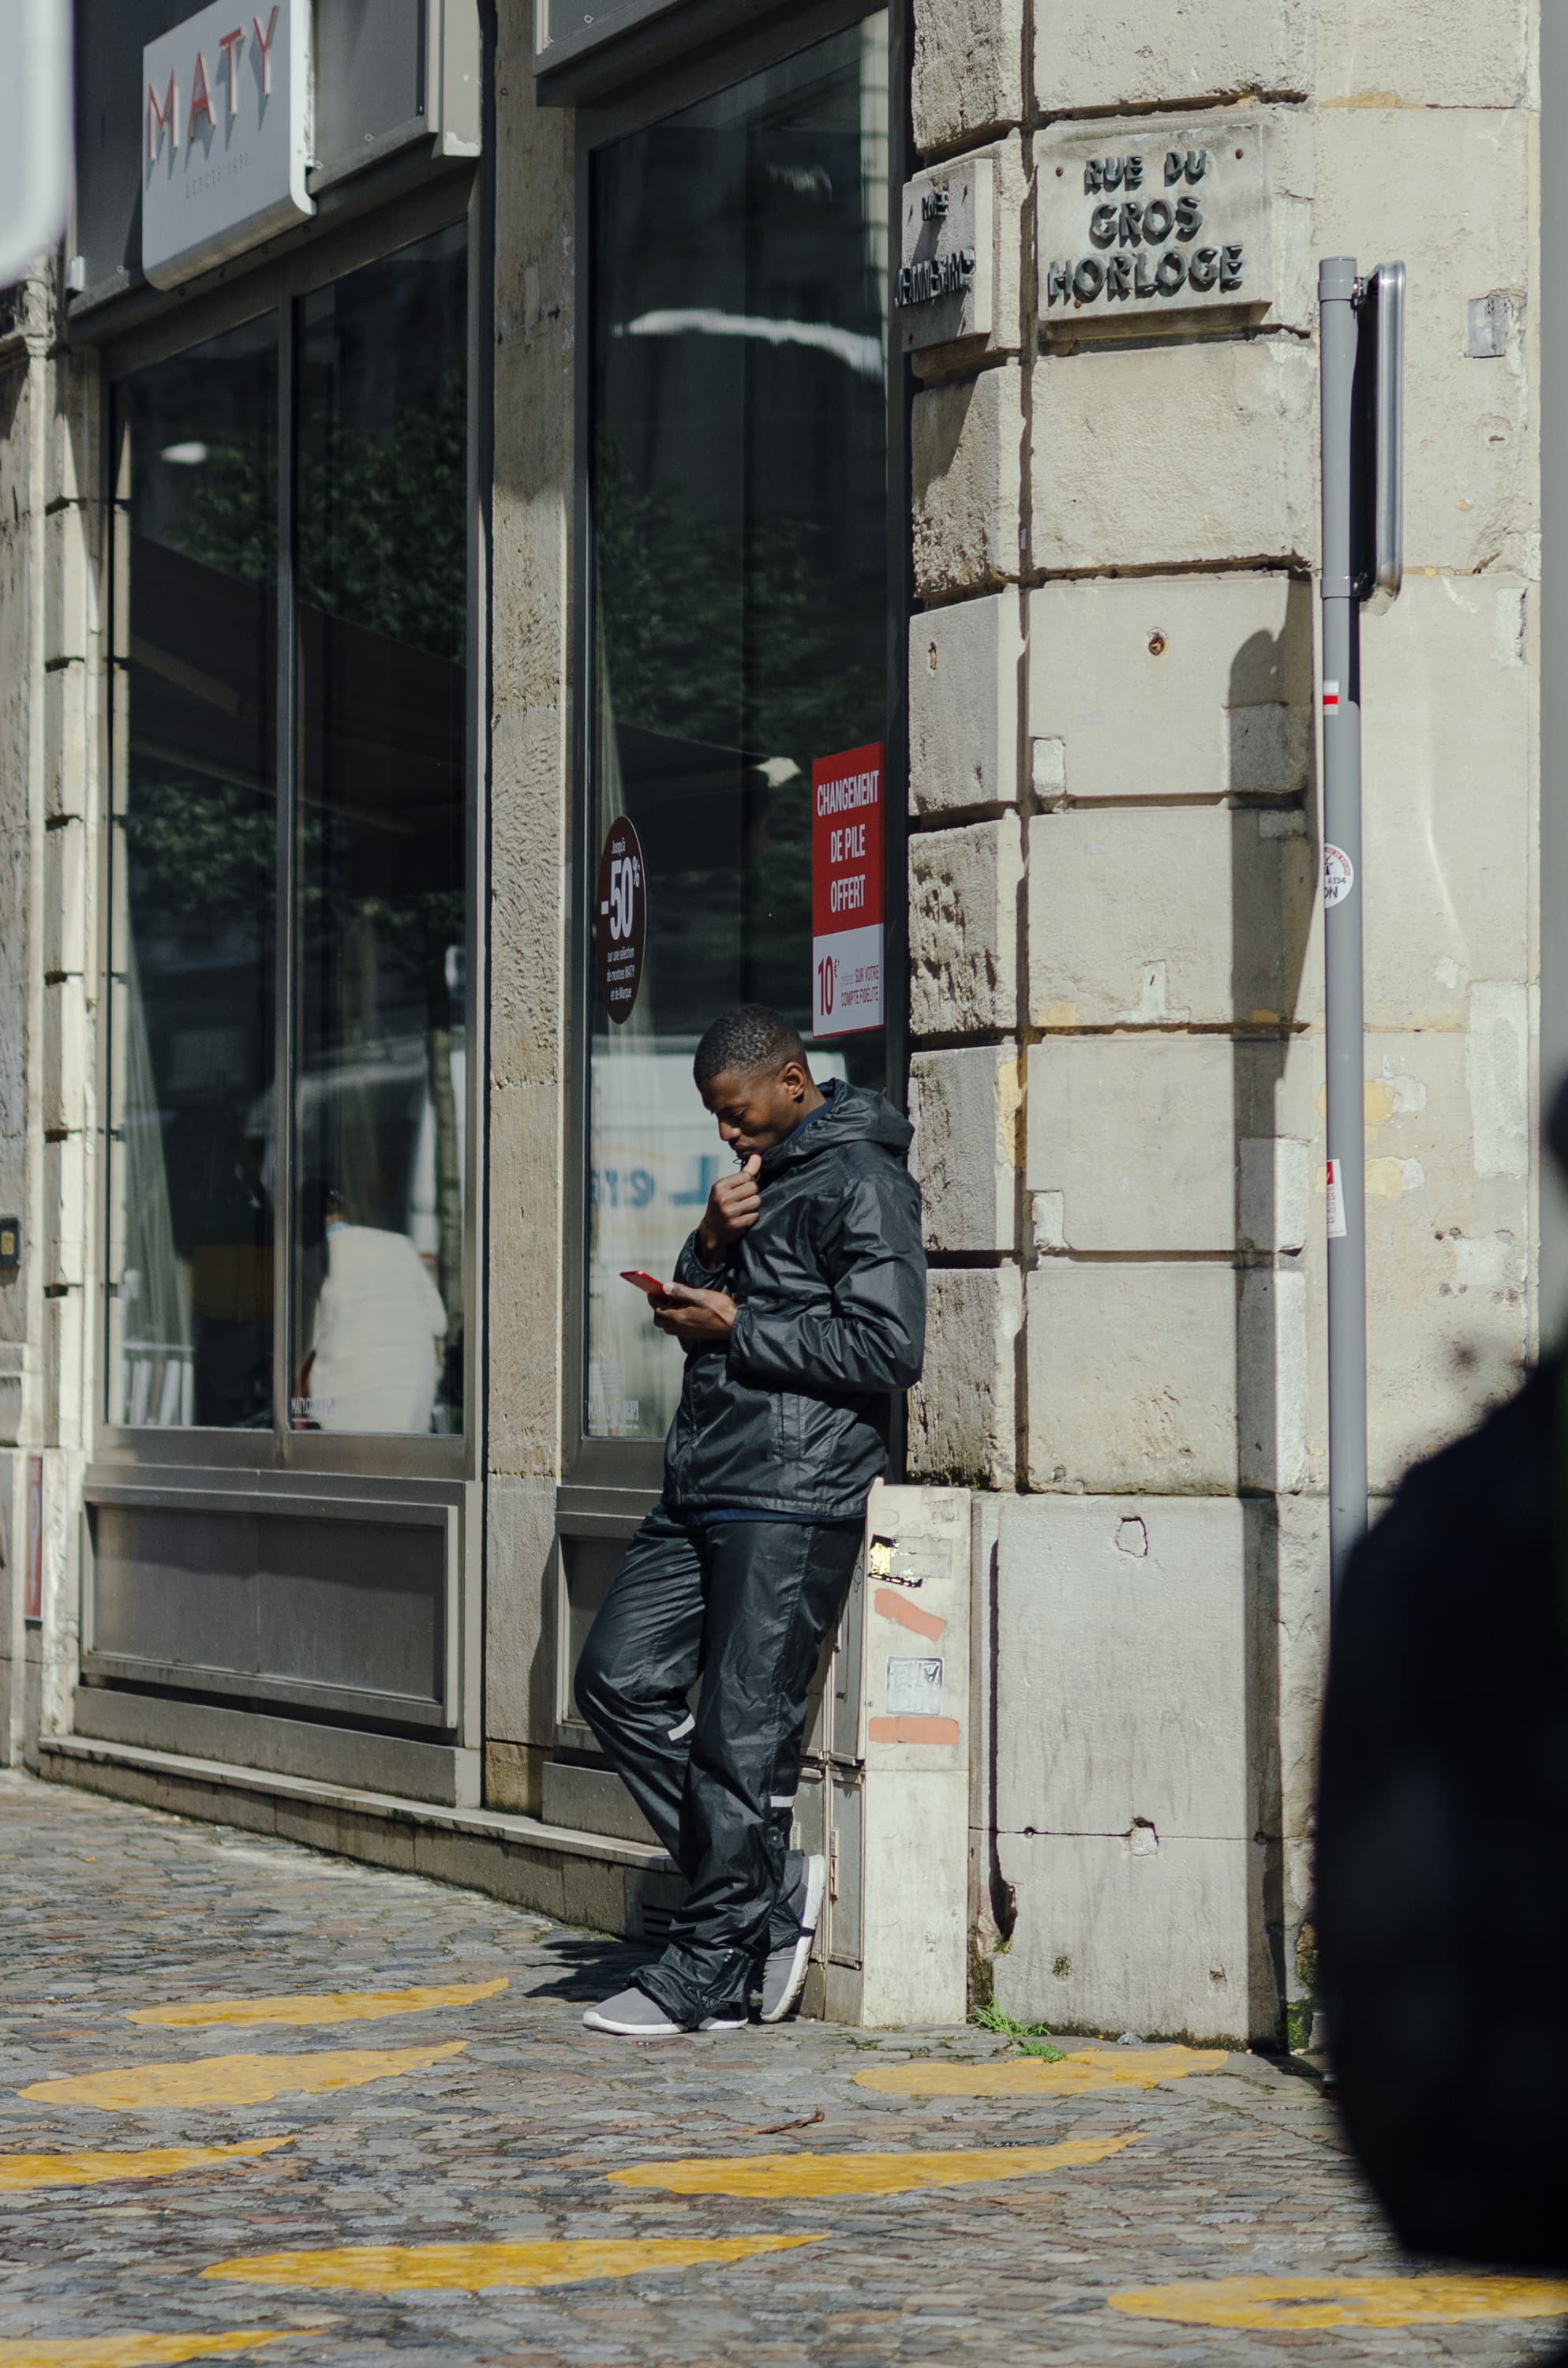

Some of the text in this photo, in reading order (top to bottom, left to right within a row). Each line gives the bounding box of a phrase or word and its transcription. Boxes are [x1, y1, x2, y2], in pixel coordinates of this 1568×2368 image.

[148, 6, 279, 163] MATY
[1084, 149, 1208, 195] RUE DU
[1090, 195, 1203, 249] GROS
[1047, 244, 1244, 308] HORLOGE
[817, 770, 880, 817] CHANGEMENT
[830, 823, 866, 864] DE PILE
[830, 874, 866, 913] OFFERT
[855, 968, 864, 984] SUR
[865, 964, 879, 982] VOTRE
[840, 989, 859, 1006] COMPTE
